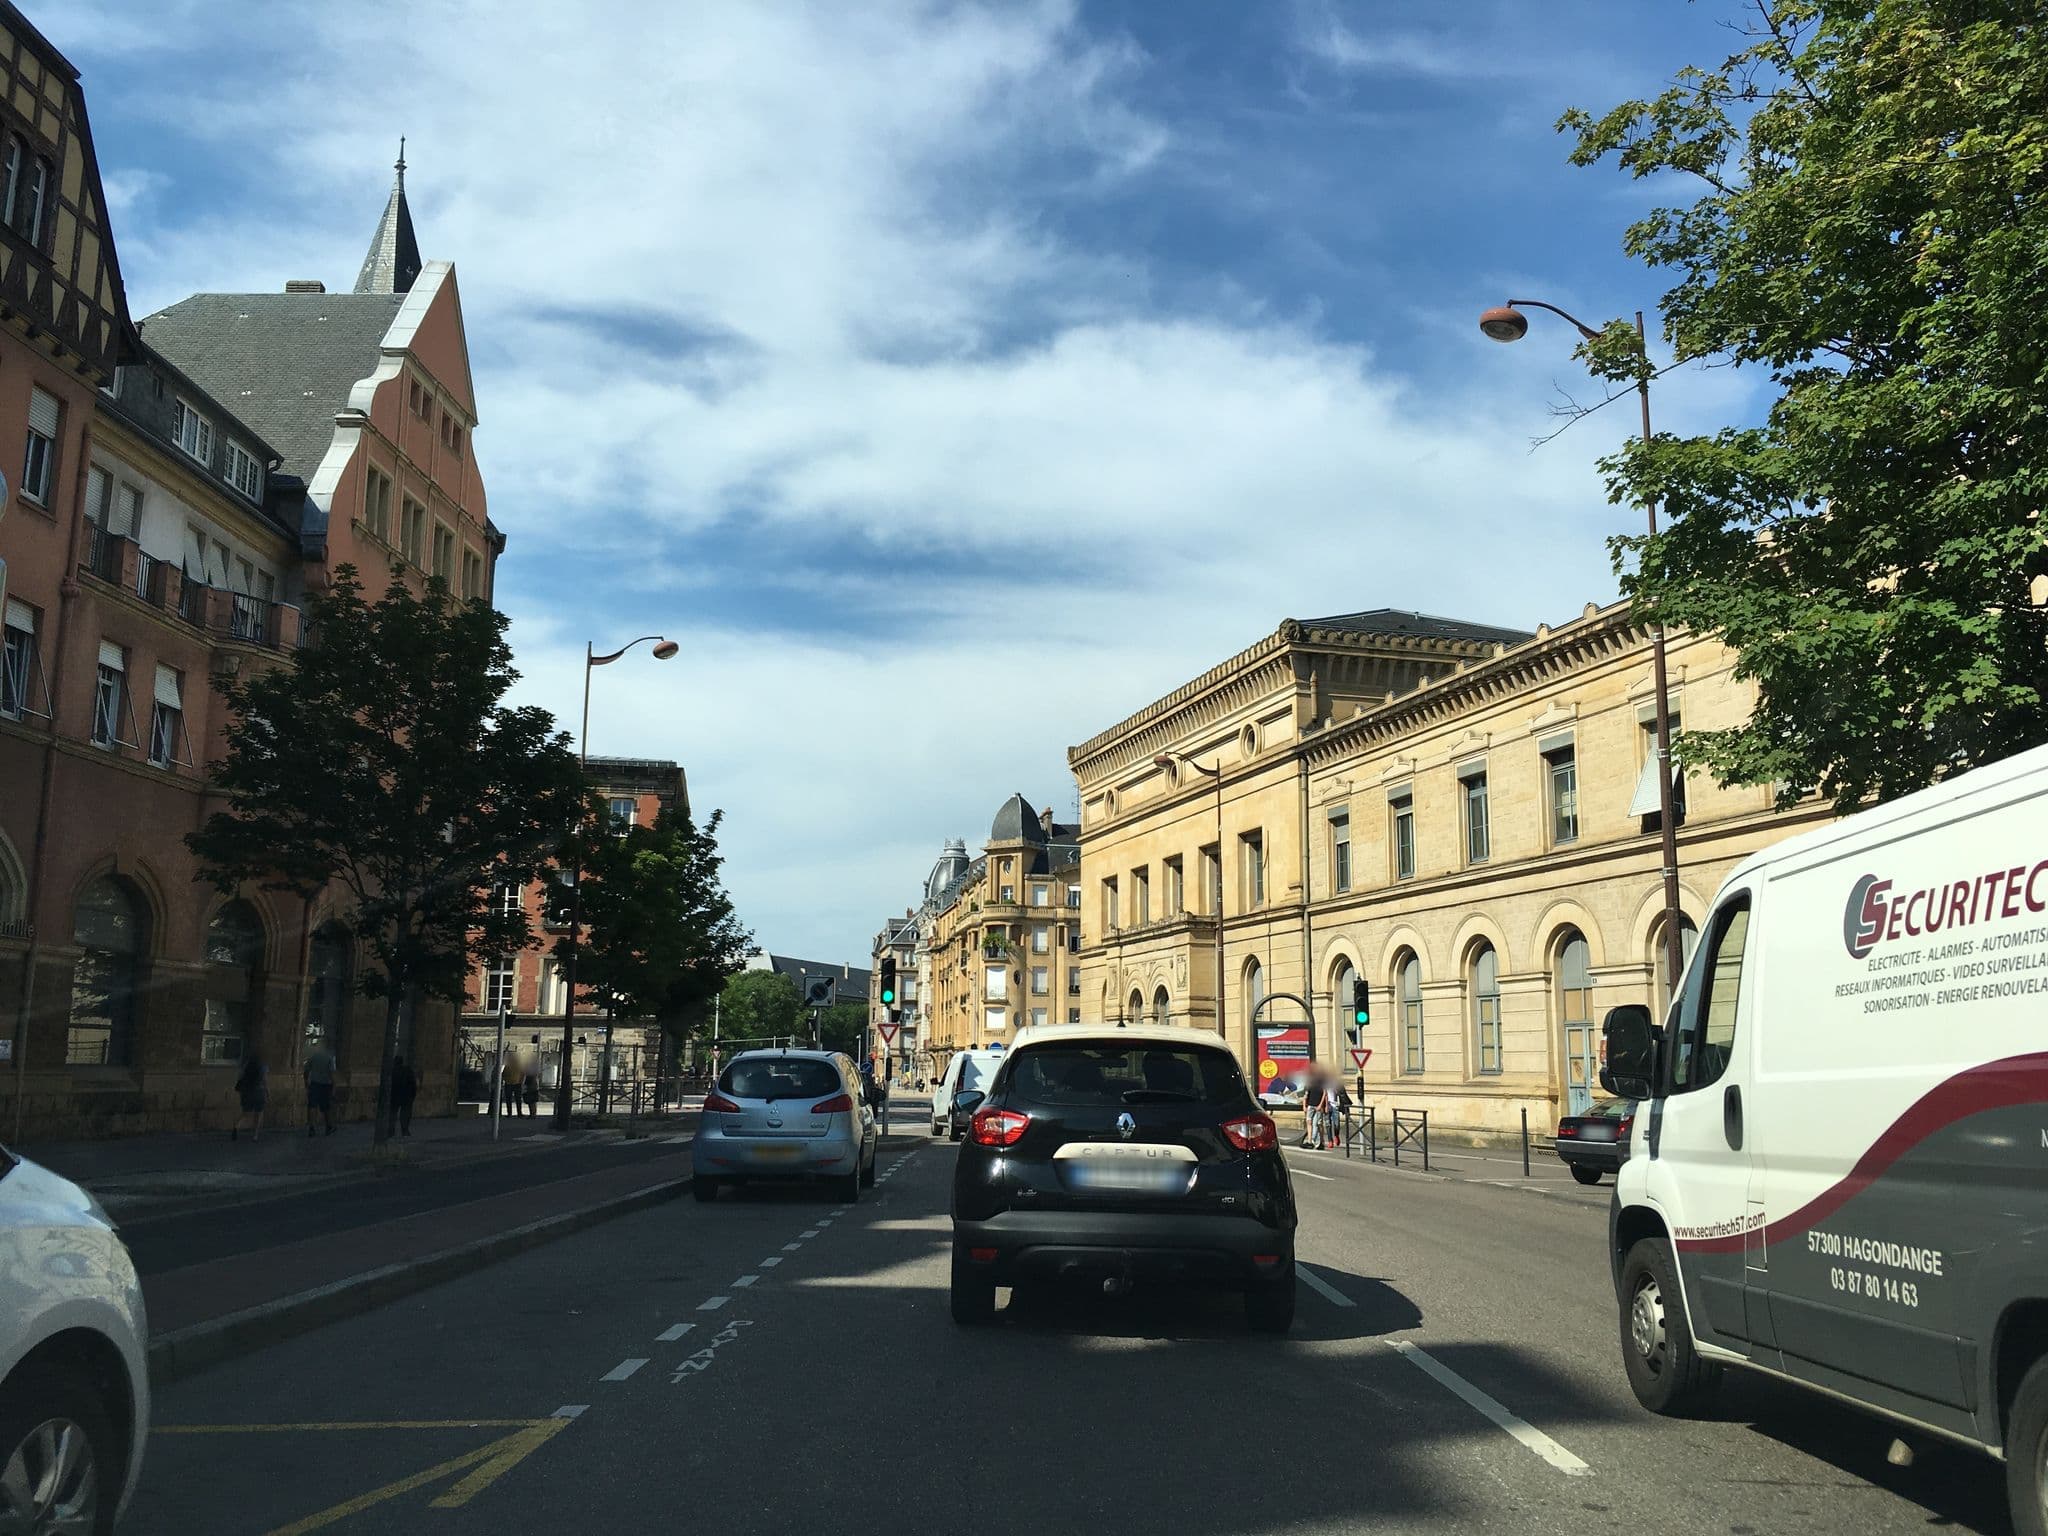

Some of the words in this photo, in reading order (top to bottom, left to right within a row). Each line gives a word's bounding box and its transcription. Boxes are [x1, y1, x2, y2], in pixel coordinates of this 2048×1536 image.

[1857, 859, 2048, 947] SECURITEC
[1835, 979, 1871, 997] RESEAUX
[1871, 967, 1945, 992] INFORMATIQUES
[1953, 961, 1985, 980] VIDEO
[1986, 951, 2048, 975] SURVEILLA
[1868, 949, 1921, 972] ELECTRICITE
[1928, 940, 1974, 961] ALARMES
[1864, 992, 1930, 1013] SONORISATION
[1937, 985, 1979, 1005] ENERGIE
[1674, 1211, 1767, 1238] www.securitech57.com
[1808, 1230, 1840, 1256] 57300
[1844, 1235, 1943, 1276] HAGONDANGE
[1831, 1267, 1846, 1290] 03
[1848, 1270, 1861, 1294] 87
[1865, 1273, 1880, 1298] 80
[1883, 1278, 1899, 1303] 14
[1902, 1281, 1919, 1307] 63
